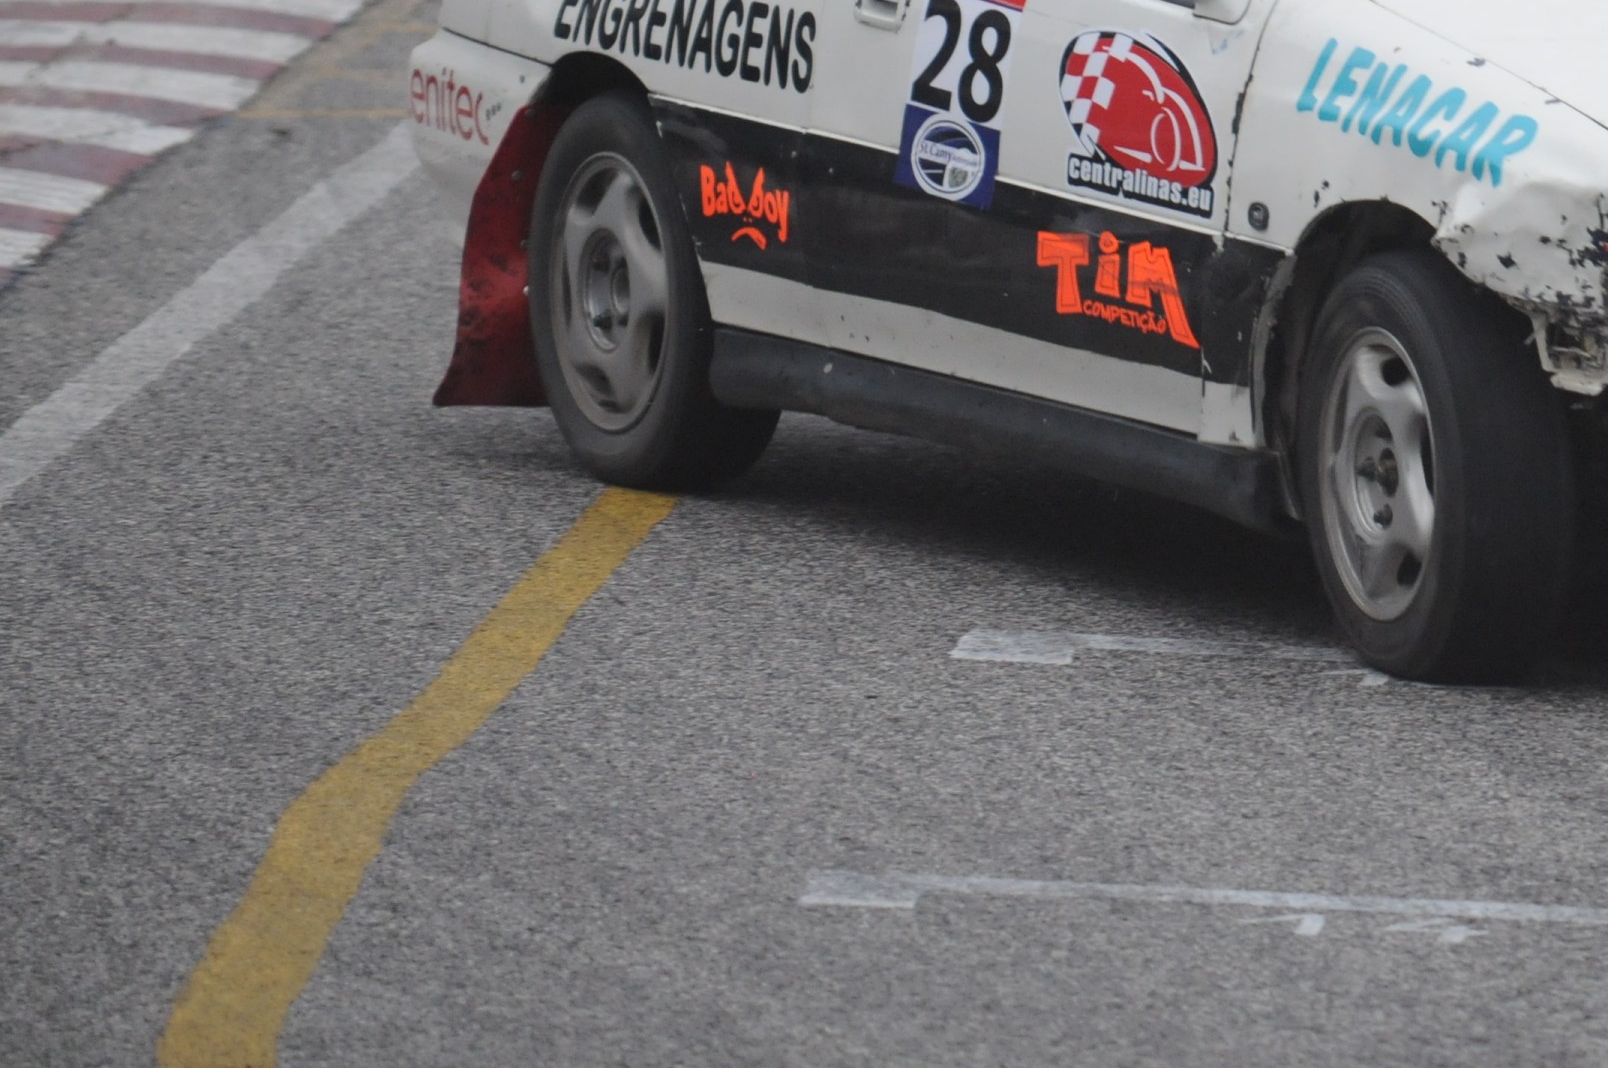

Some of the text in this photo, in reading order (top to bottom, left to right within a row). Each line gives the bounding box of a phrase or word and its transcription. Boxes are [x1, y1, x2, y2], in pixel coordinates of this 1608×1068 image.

[1296, 37, 1539, 188] LENACAR
[700, 161, 746, 217] Bad
[1068, 156, 1212, 212] centralinas.eu
[1083, 299, 1167, 334] COMPETIÇÃO
